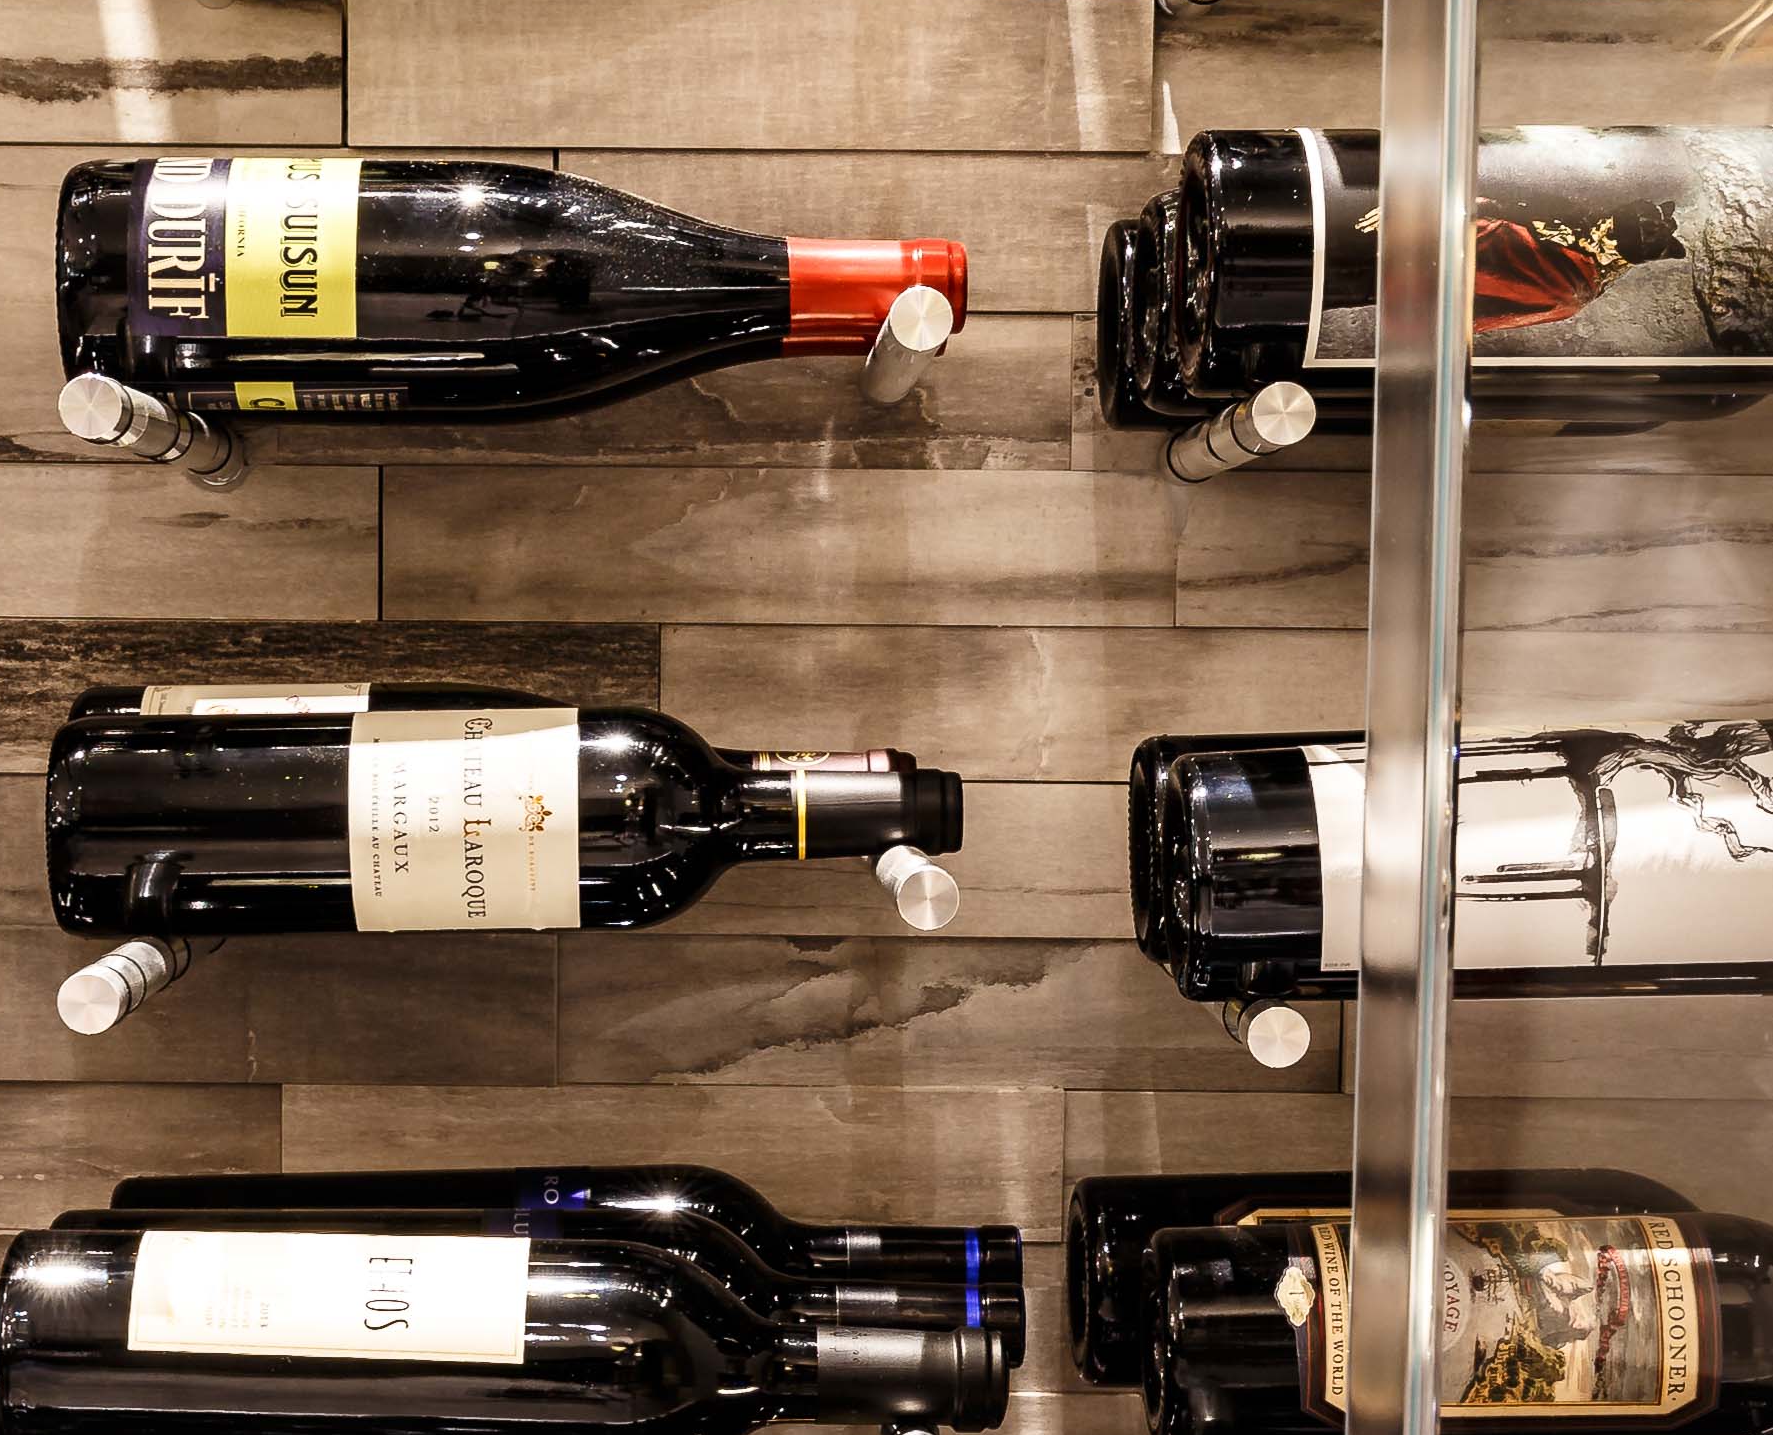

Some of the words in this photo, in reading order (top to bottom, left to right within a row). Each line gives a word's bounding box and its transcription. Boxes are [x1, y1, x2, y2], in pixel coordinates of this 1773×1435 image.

[392, 763, 410, 874] MARGAUX
[372, 836, 379, 850] AU
[461, 817, 492, 919] LAROQUE
[1648, 1221, 1673, 1250] RED
[1323, 1242, 1338, 1274] WINE
[1329, 1277, 1341, 1296] OF
[1331, 1301, 1343, 1334] THE
[1331, 1340, 1344, 1396] WORLD
